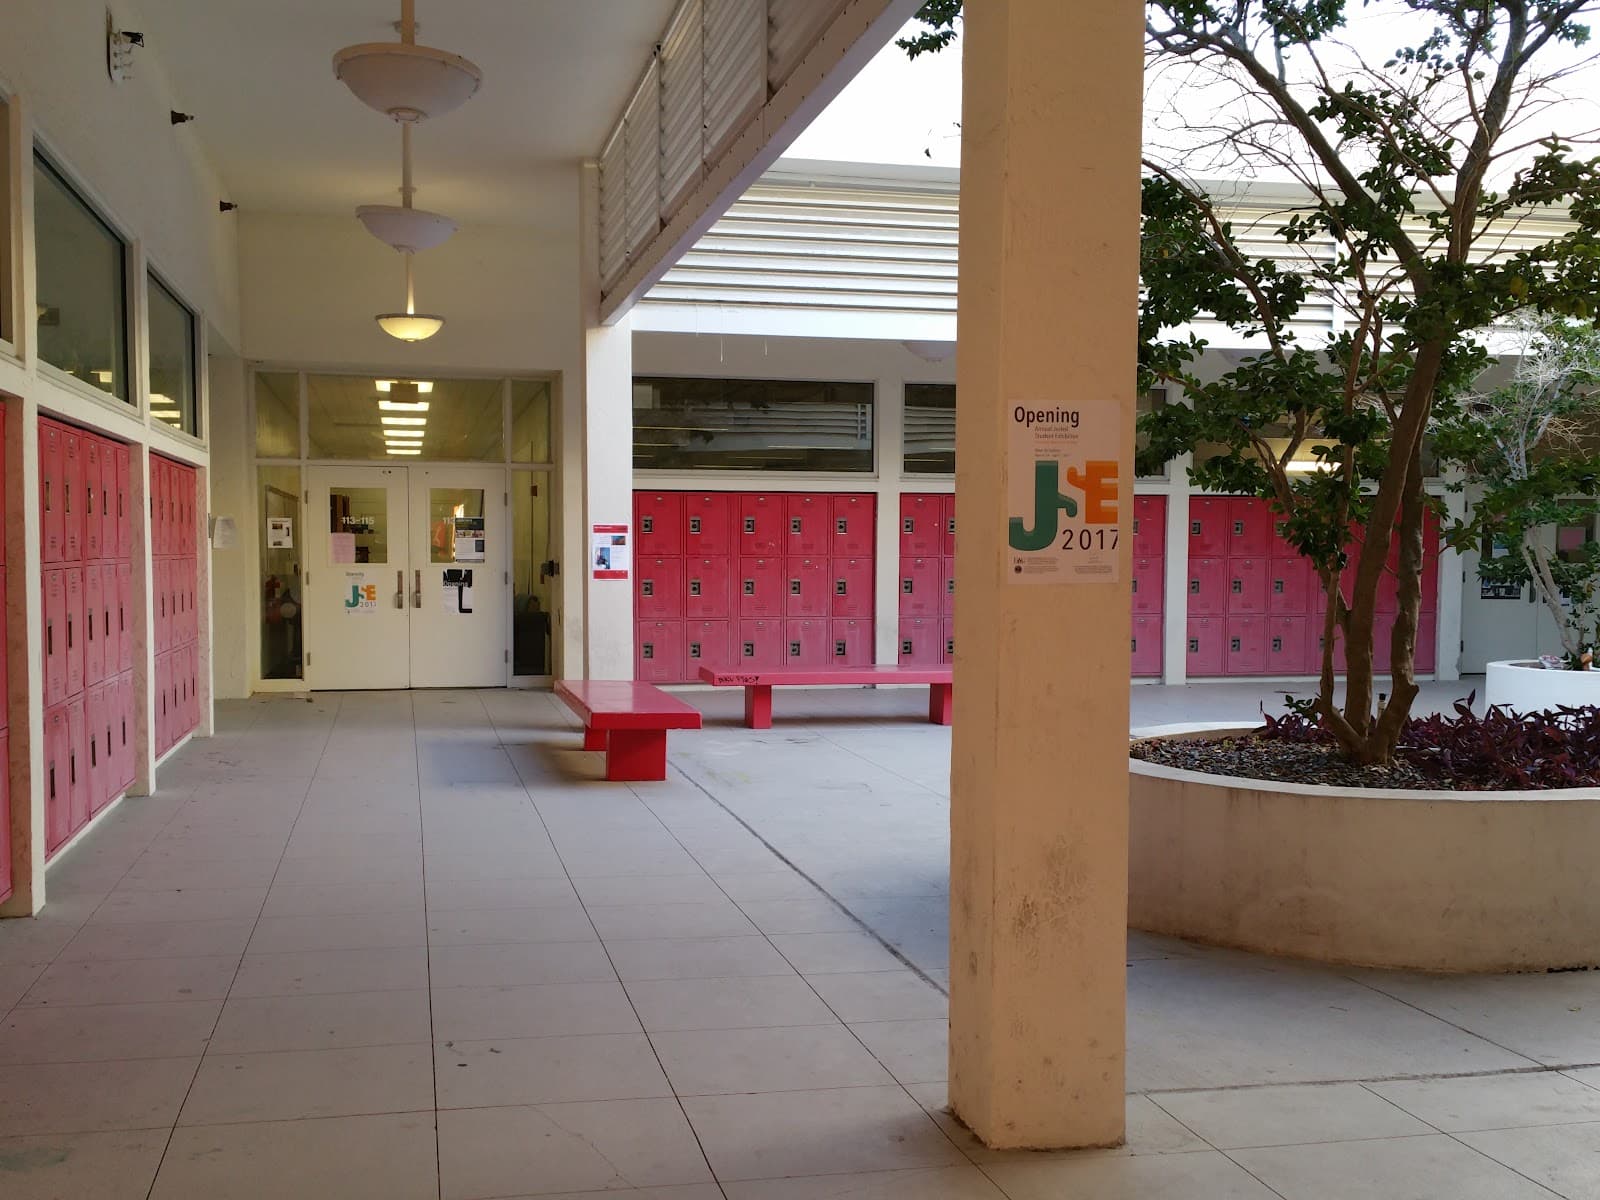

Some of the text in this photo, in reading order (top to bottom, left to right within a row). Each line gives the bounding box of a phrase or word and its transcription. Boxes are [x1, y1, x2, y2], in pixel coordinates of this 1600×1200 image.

[1014, 406, 1080, 428] Opening
[341, 516, 375, 525] 113-115
[1061, 529, 1119, 550] 2017
